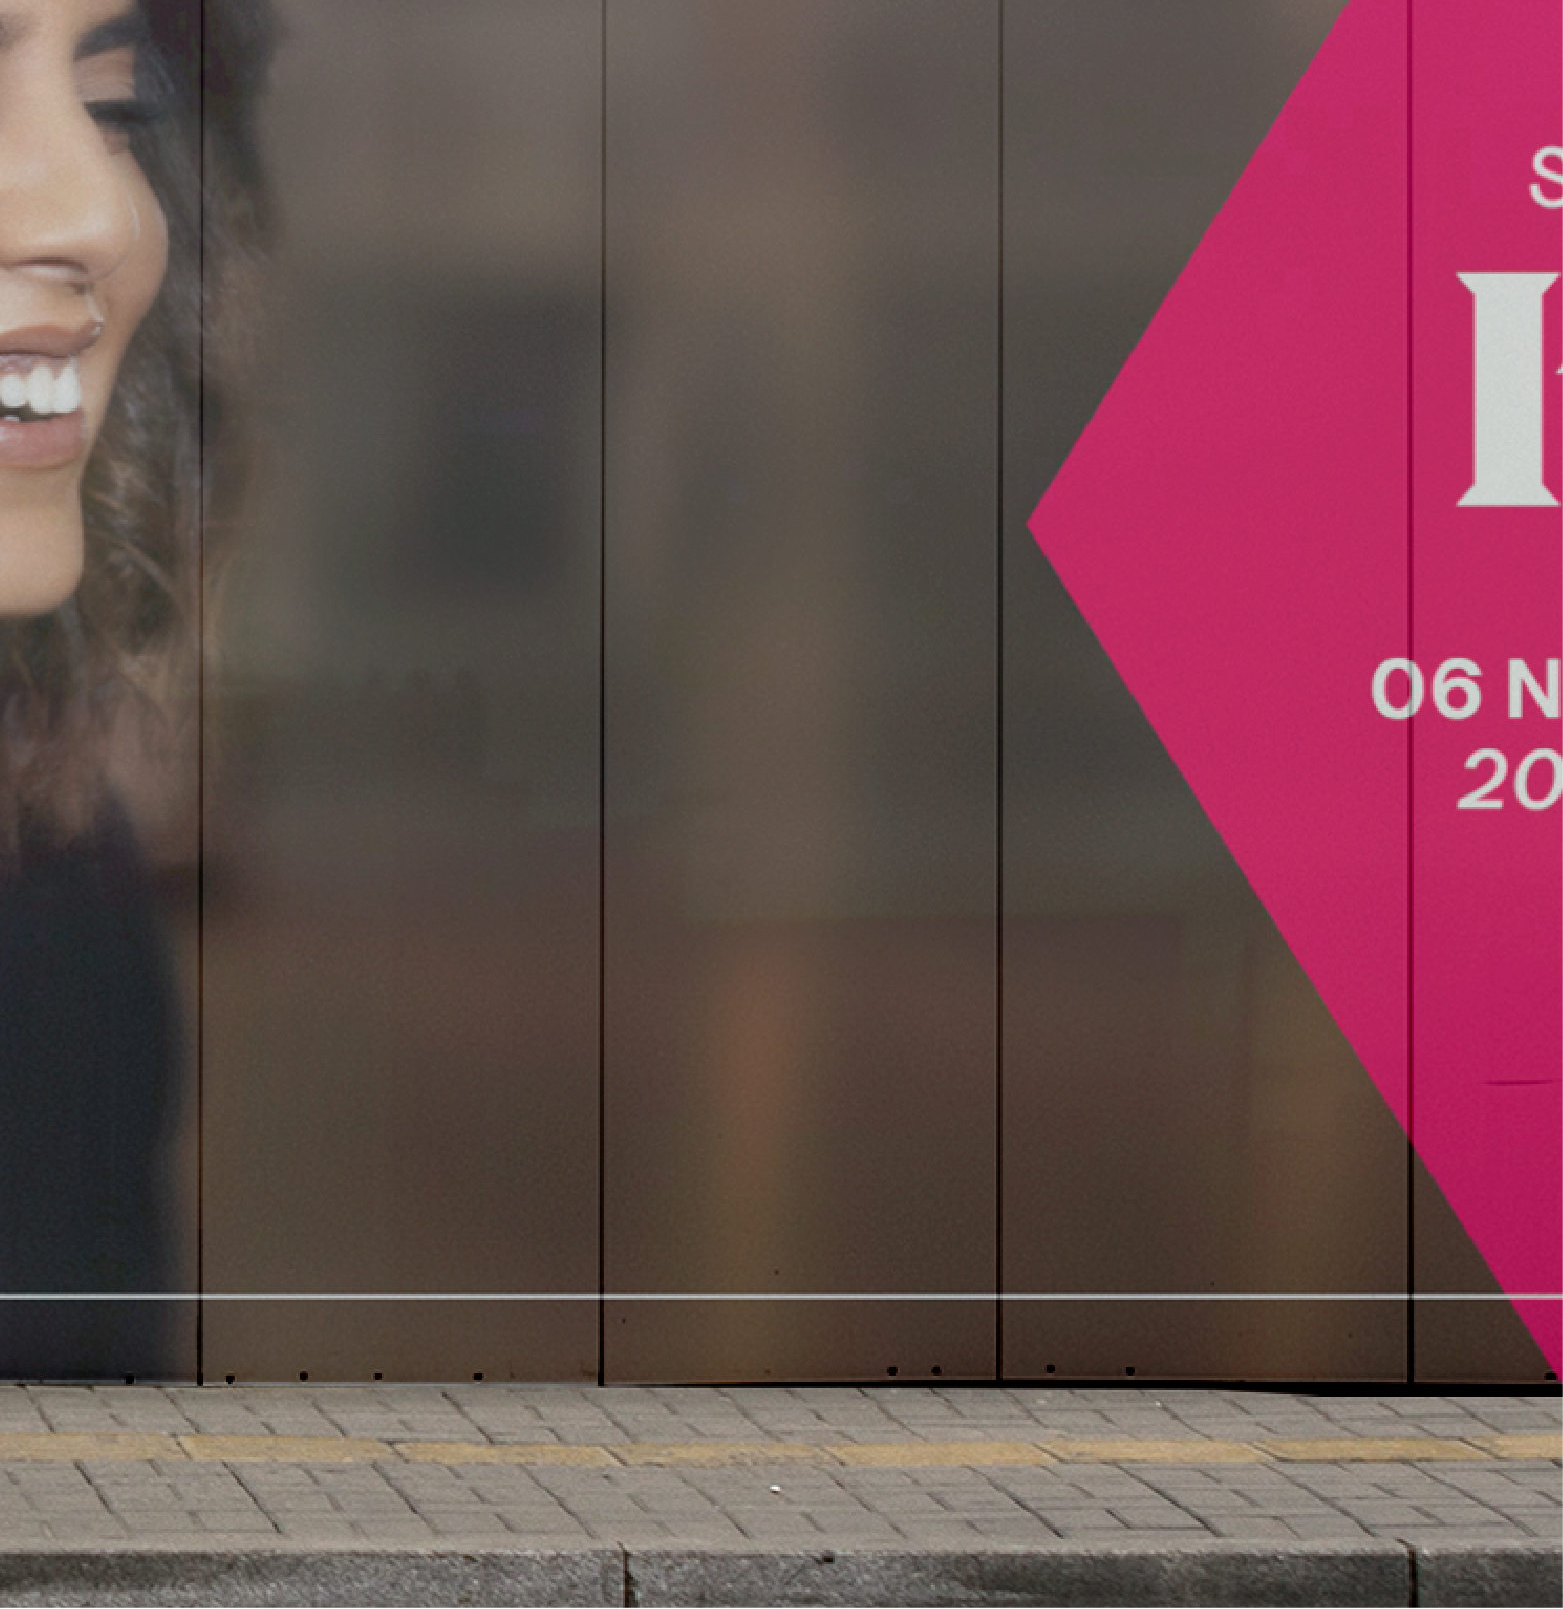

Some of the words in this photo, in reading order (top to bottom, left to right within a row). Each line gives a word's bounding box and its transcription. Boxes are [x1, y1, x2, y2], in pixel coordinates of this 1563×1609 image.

[1457, 271, 1563, 506] I
[1371, 657, 1482, 720] 06
[1508, 657, 1560, 719] N
[1457, 747, 1563, 810] 20
